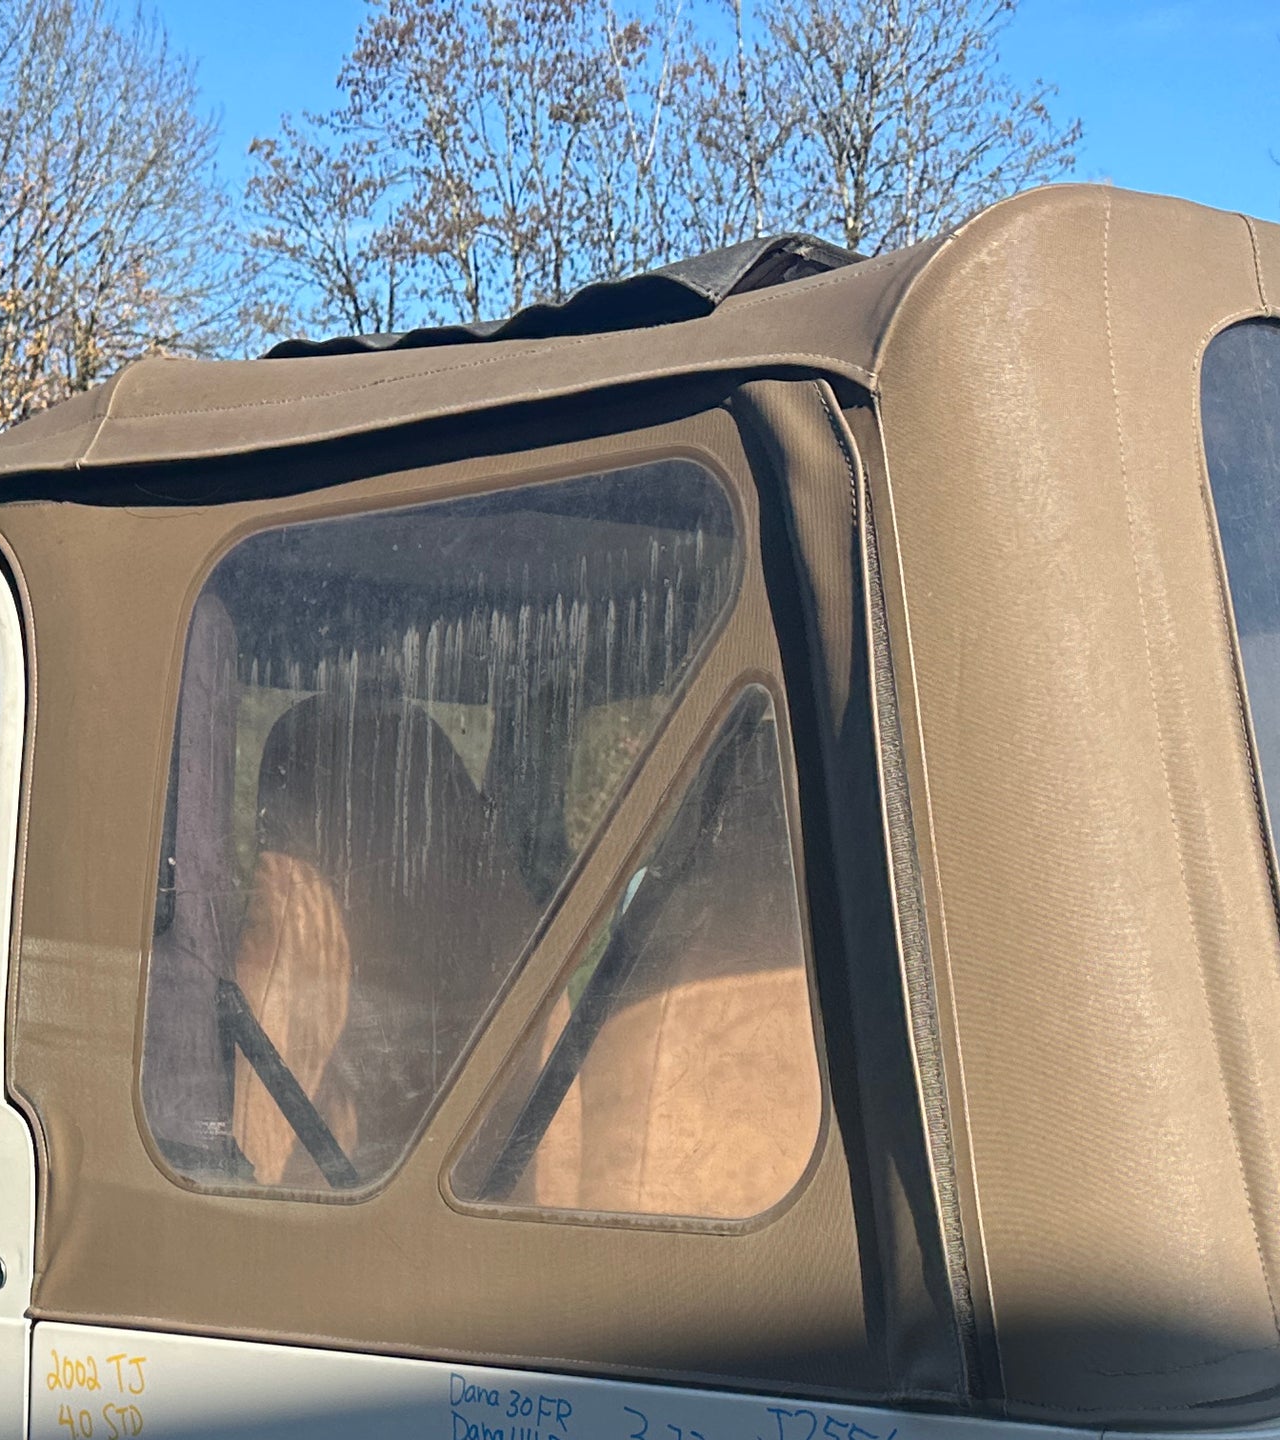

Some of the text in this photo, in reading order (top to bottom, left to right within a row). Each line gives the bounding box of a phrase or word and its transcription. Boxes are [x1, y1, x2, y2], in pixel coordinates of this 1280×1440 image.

[47, 1349, 147, 1394] 2002 TJ
[449, 1372, 500, 1407] Dana
